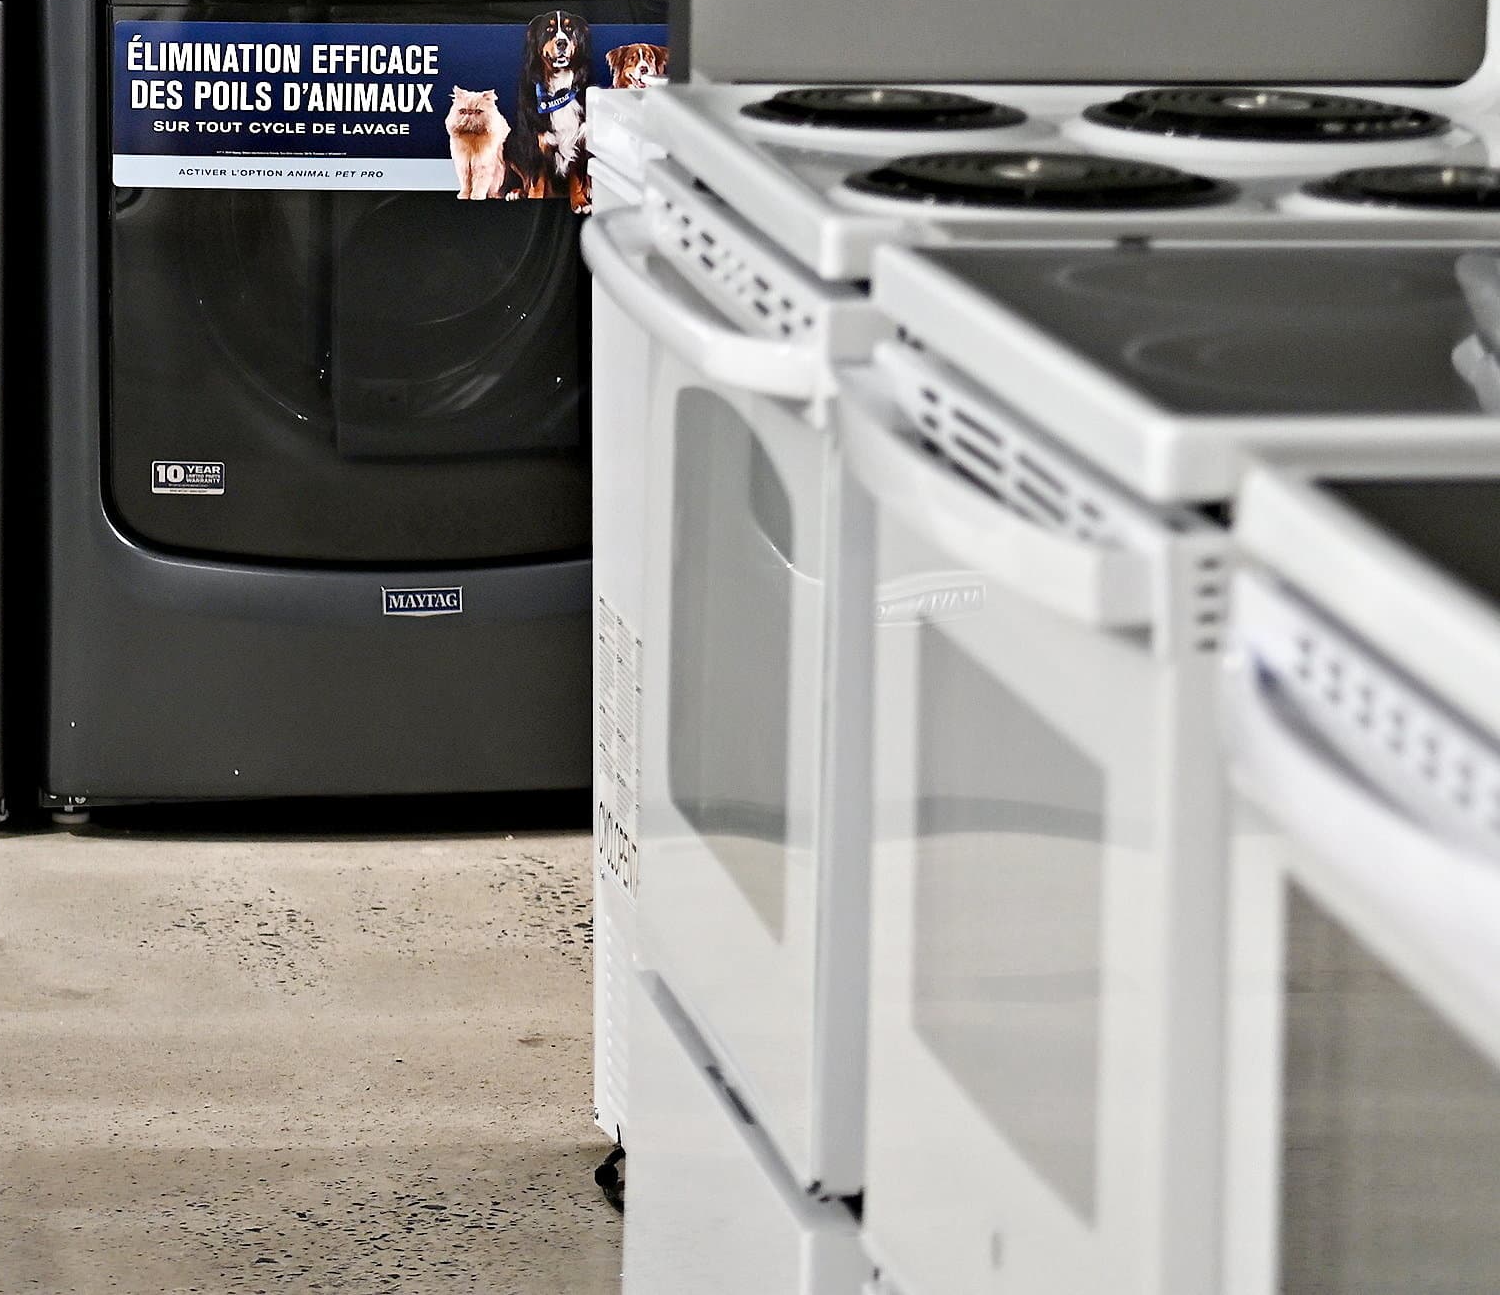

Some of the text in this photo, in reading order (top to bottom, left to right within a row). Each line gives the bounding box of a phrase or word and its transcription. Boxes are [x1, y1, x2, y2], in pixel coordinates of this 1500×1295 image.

[127, 34, 438, 75] ÉLIMINATION EFFICACE
[131, 79, 434, 113] DES POILS D'ANIMAUX
[153, 120, 410, 136] SUR TOUT CYCLE DE LAVAGE
[179, 169, 384, 178] ACTIVER L'OPTION ANIMAL PET PRO
[157, 465, 184, 482] 10
[389, 593, 457, 609] MAYTAG
